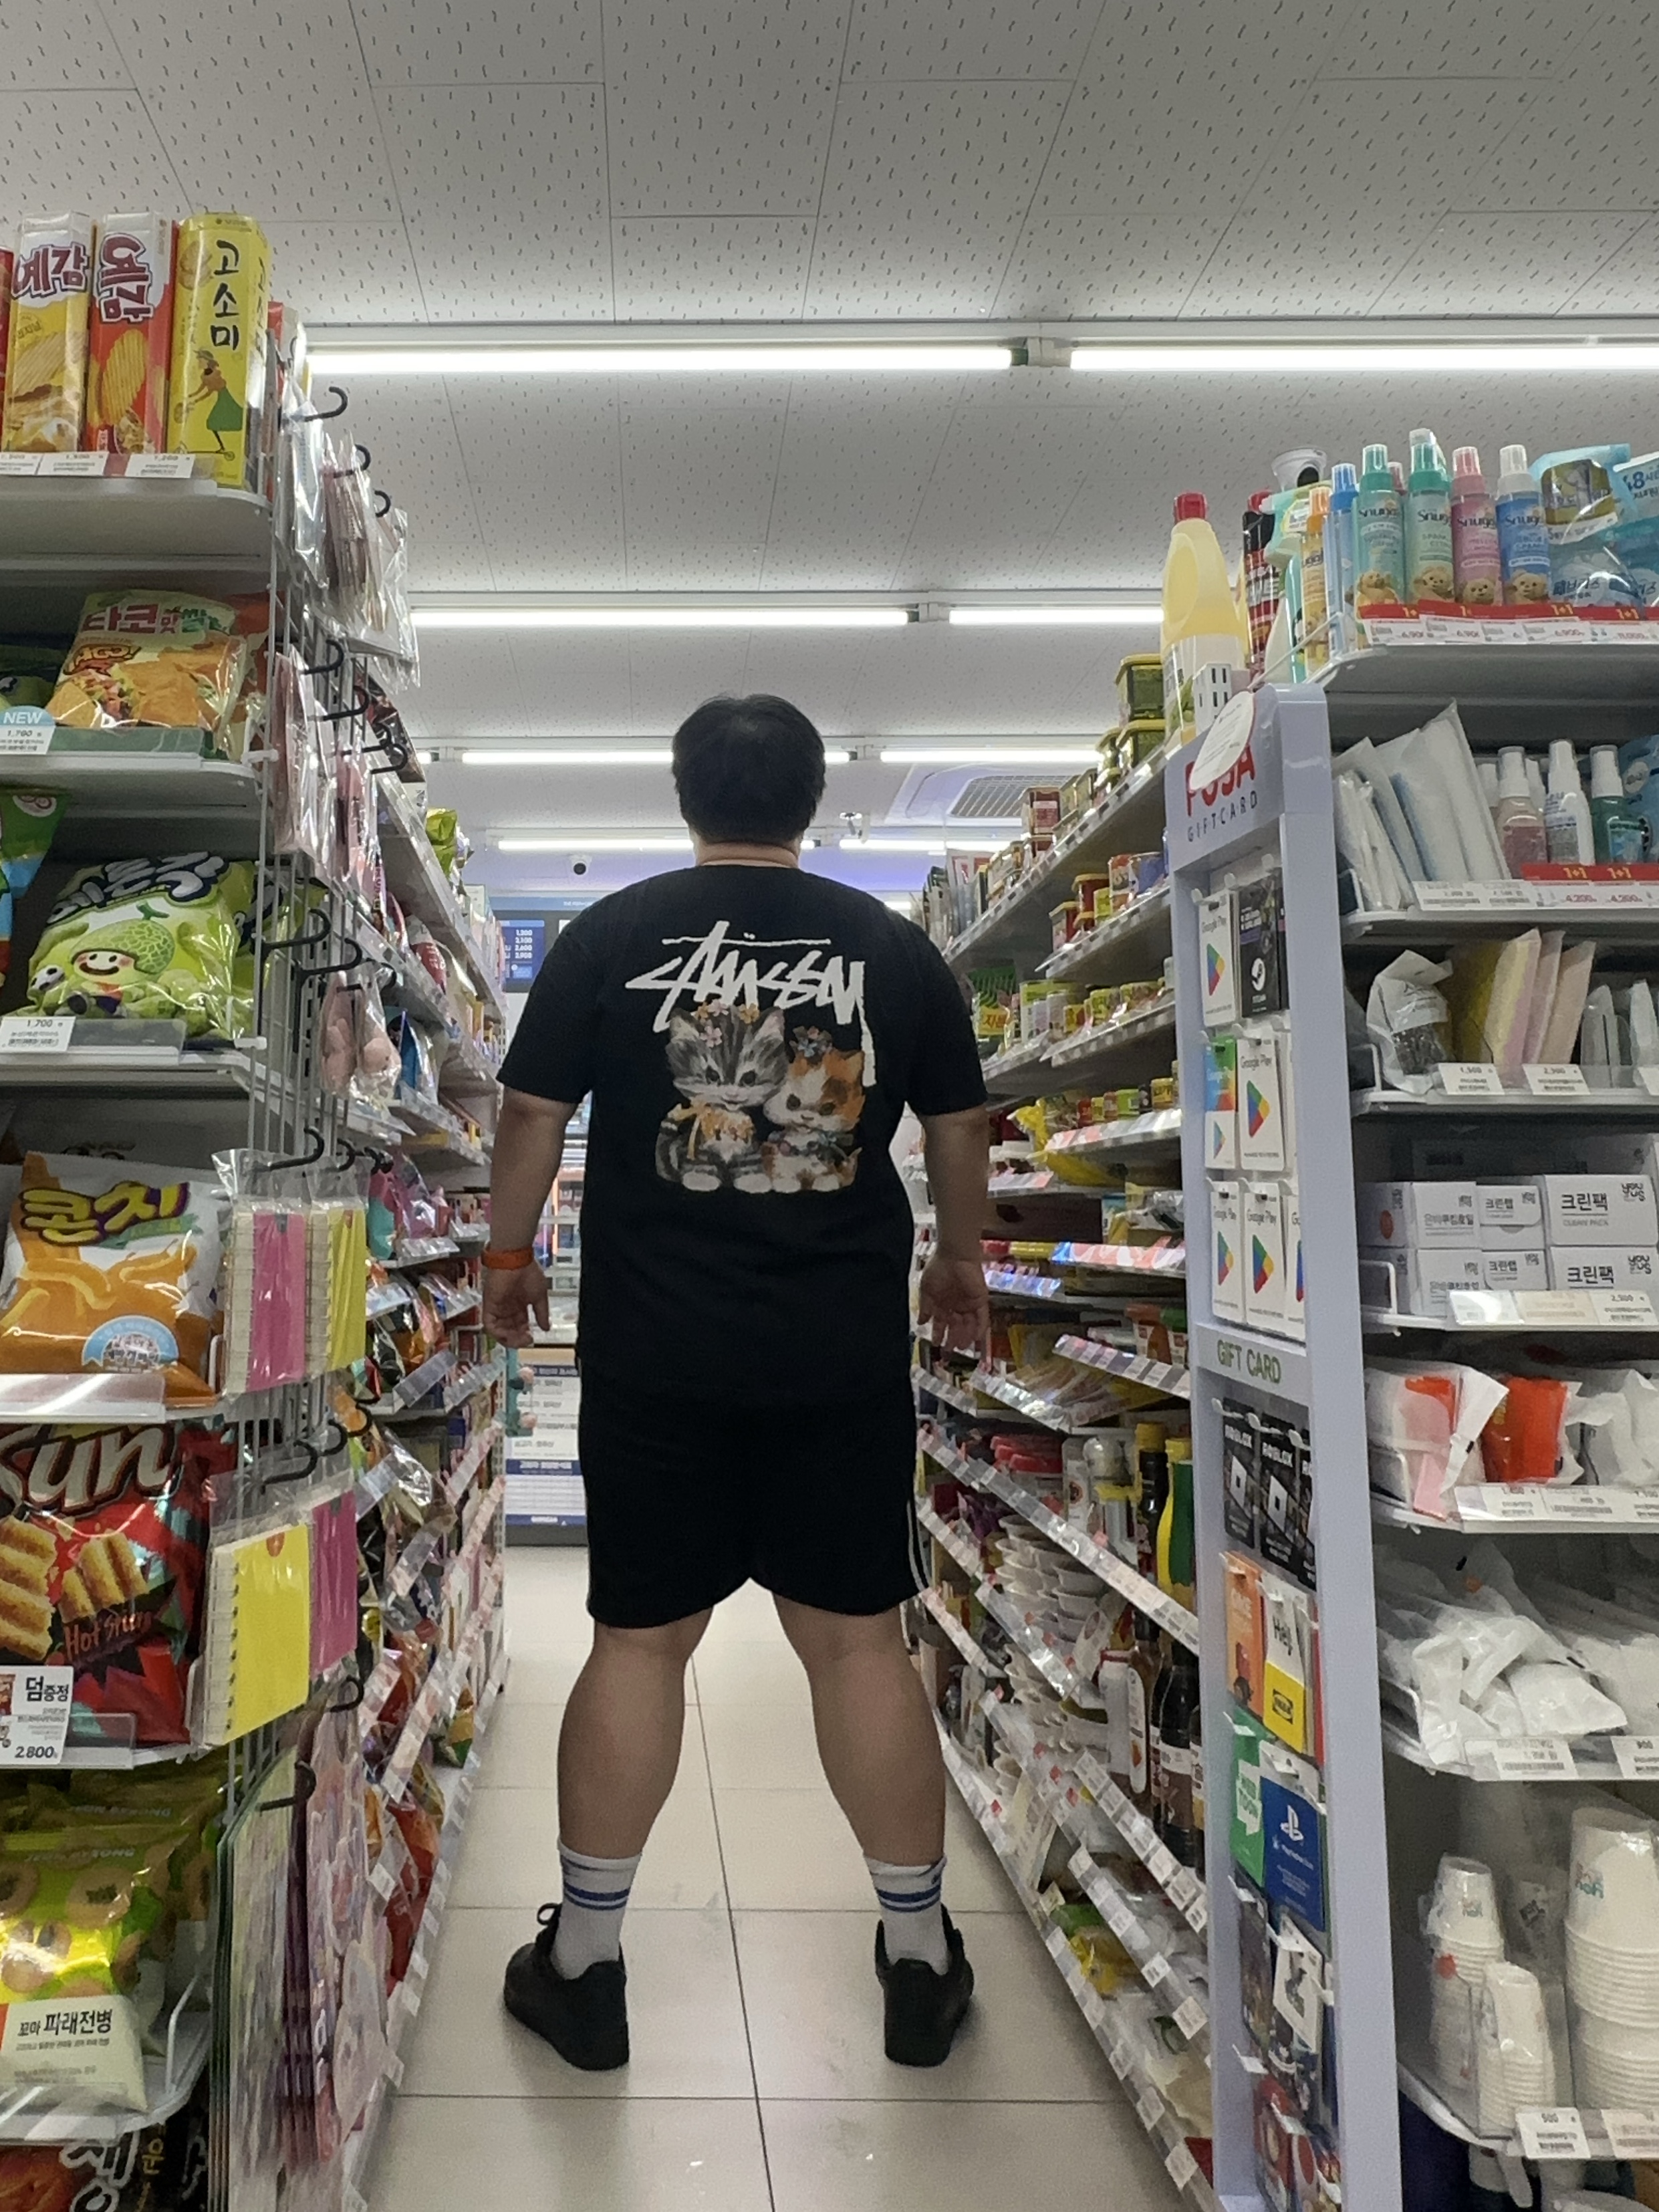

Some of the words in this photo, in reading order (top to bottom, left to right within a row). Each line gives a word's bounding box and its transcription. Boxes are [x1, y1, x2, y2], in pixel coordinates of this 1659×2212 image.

[11, 243, 90, 299] 예감
[95, 233, 153, 324] 예감
[210, 239, 239, 350] 고소미
[1551, 604, 1573, 615] 1+1
[1616, 608, 1639, 619] 1+1
[3, 711, 43, 724] NEW
[1563, 867, 1587, 878] 1+1
[1607, 867, 1632, 878] 1+1
[1561, 1193, 1608, 1211] 크린팩
[1567, 1265, 1614, 1284] 크린팩
[1217, 1339, 1242, 1372] GIFT
[1247, 1348, 1281, 1385] CARD
[65, 1623, 100, 1662] Hot
[17, 2020, 41, 2037] 꼬마
